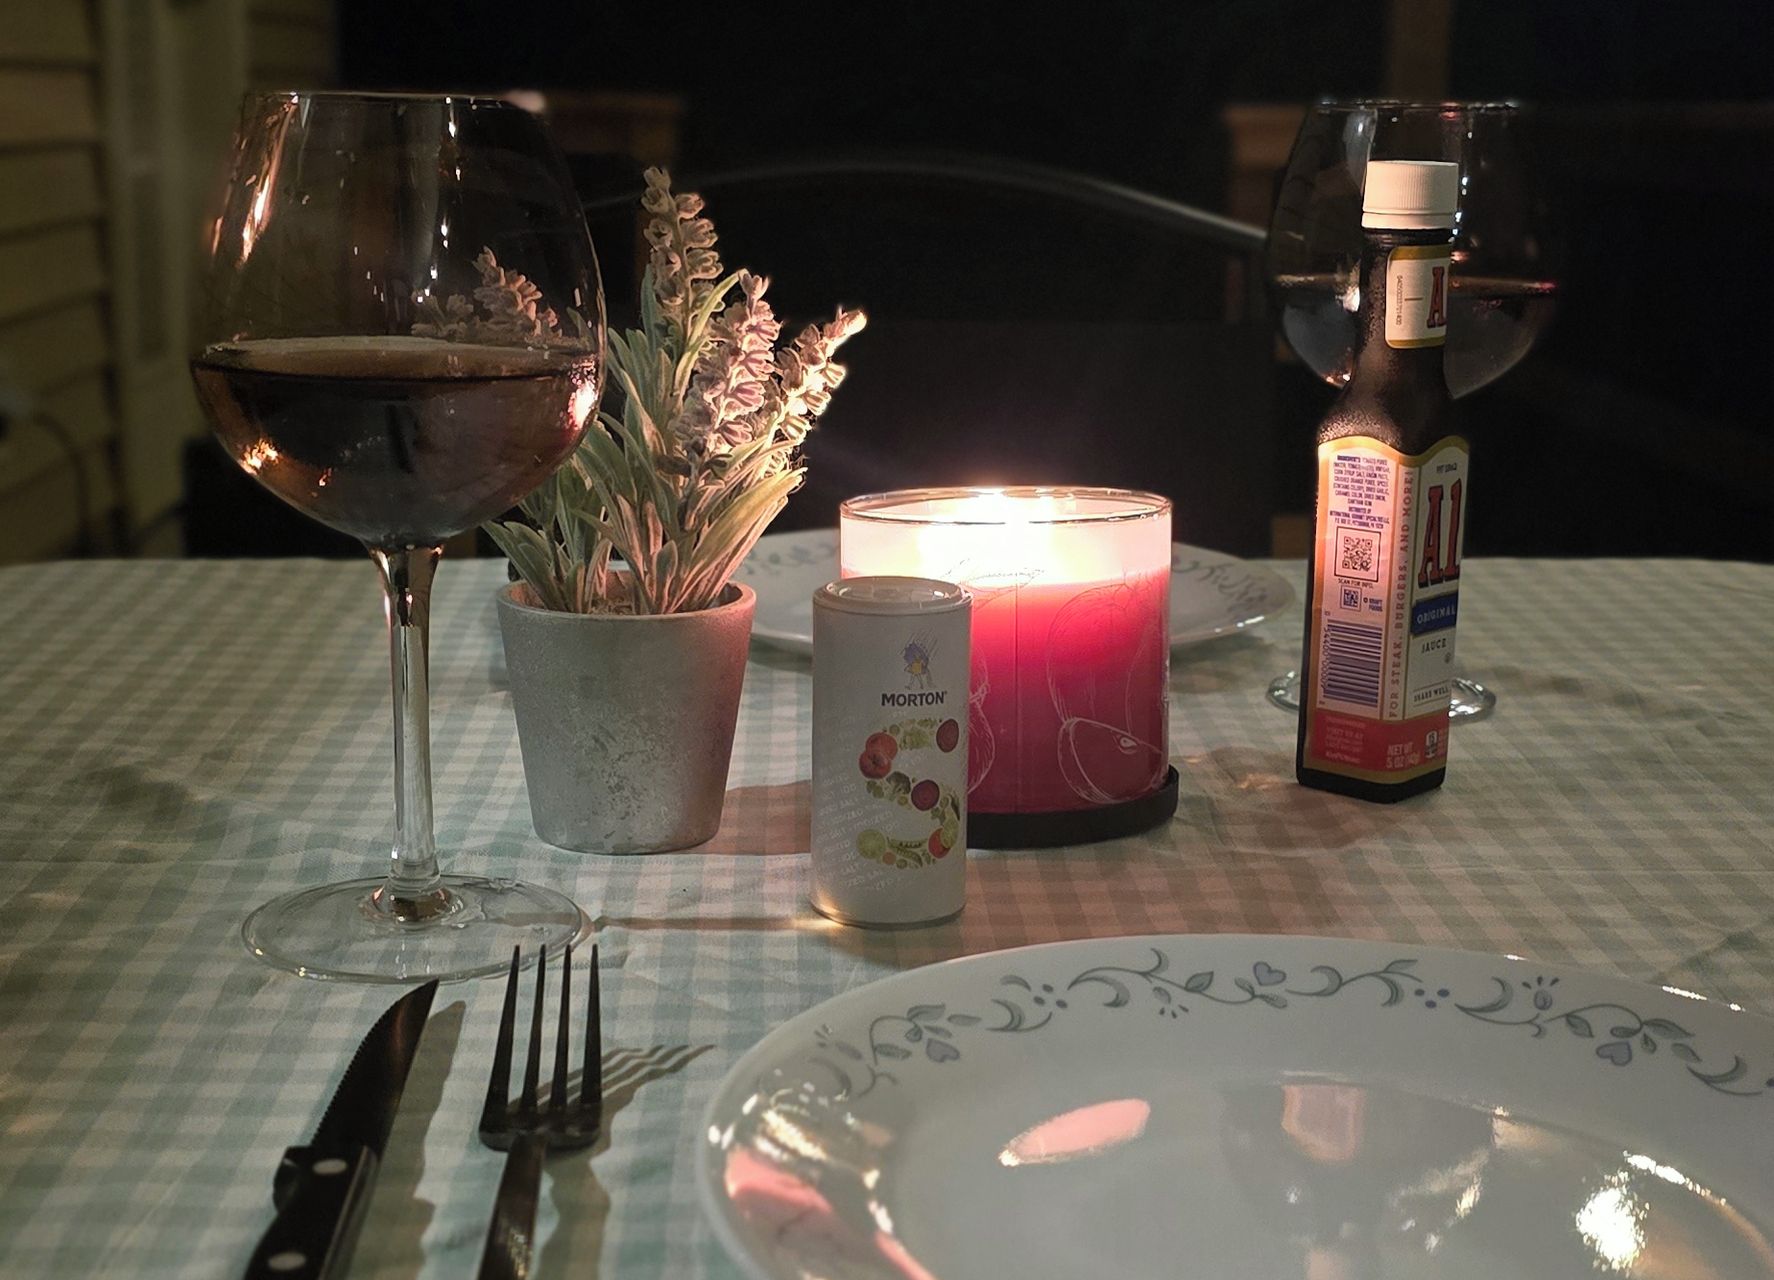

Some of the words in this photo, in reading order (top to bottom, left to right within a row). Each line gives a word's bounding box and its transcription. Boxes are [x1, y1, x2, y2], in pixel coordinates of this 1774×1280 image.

[1402, 471, 1413, 517] MORE!
[1400, 524, 1409, 552] AND
[1416, 606, 1455, 624] ORIGINAL
[1422, 638, 1447, 653] SAUCE
[881, 691, 944, 707] MORTON
[1389, 692, 1399, 718] FOR
